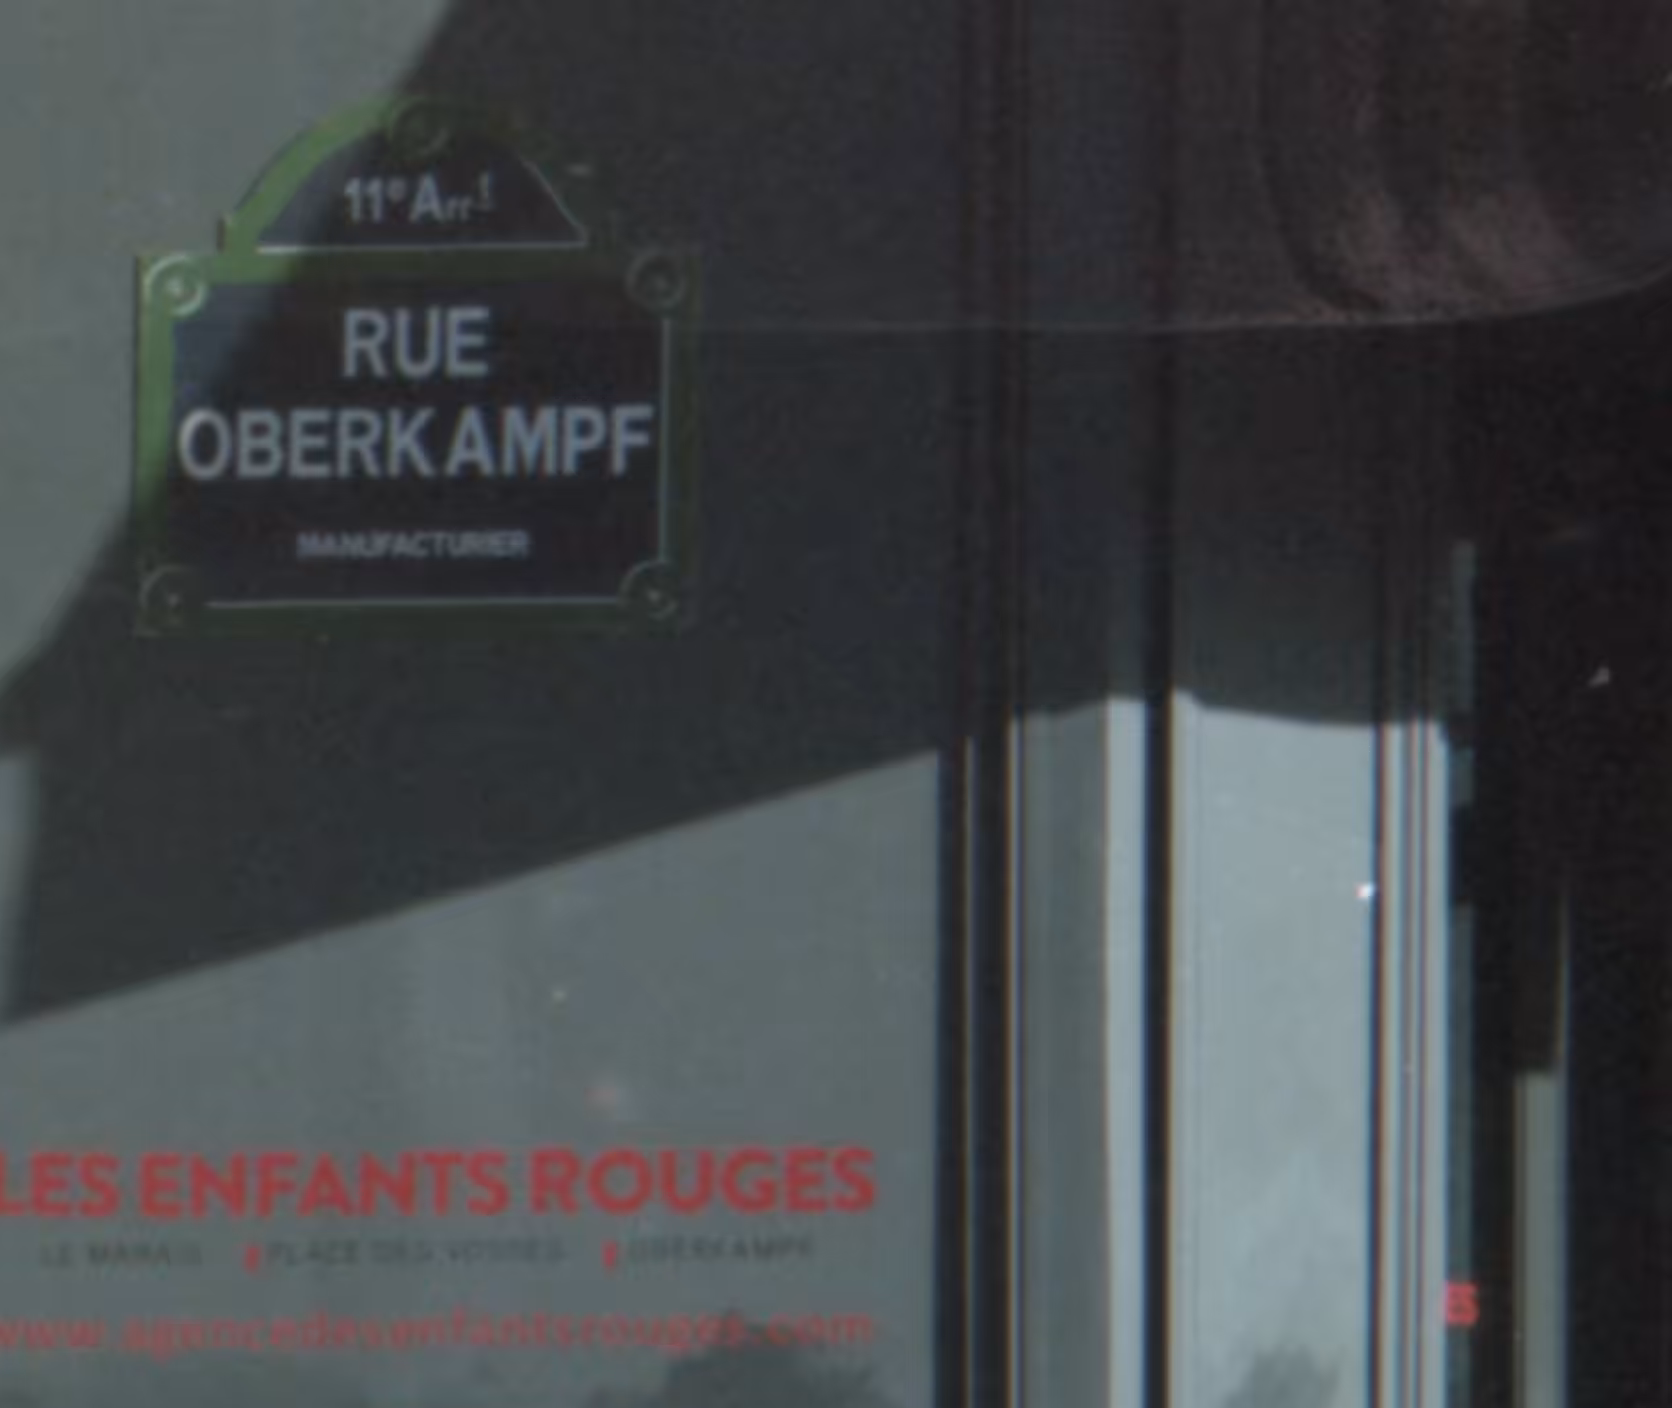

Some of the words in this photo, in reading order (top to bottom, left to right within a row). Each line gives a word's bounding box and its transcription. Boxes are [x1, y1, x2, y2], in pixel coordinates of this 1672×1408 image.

[342, 305, 492, 379] RUE
[178, 402, 657, 480] OBERKAMPF
[297, 529, 531, 559] MANUFACTURIER
[139, 1148, 509, 1221] ENFANTS
[530, 1145, 878, 1216] ROUGES
